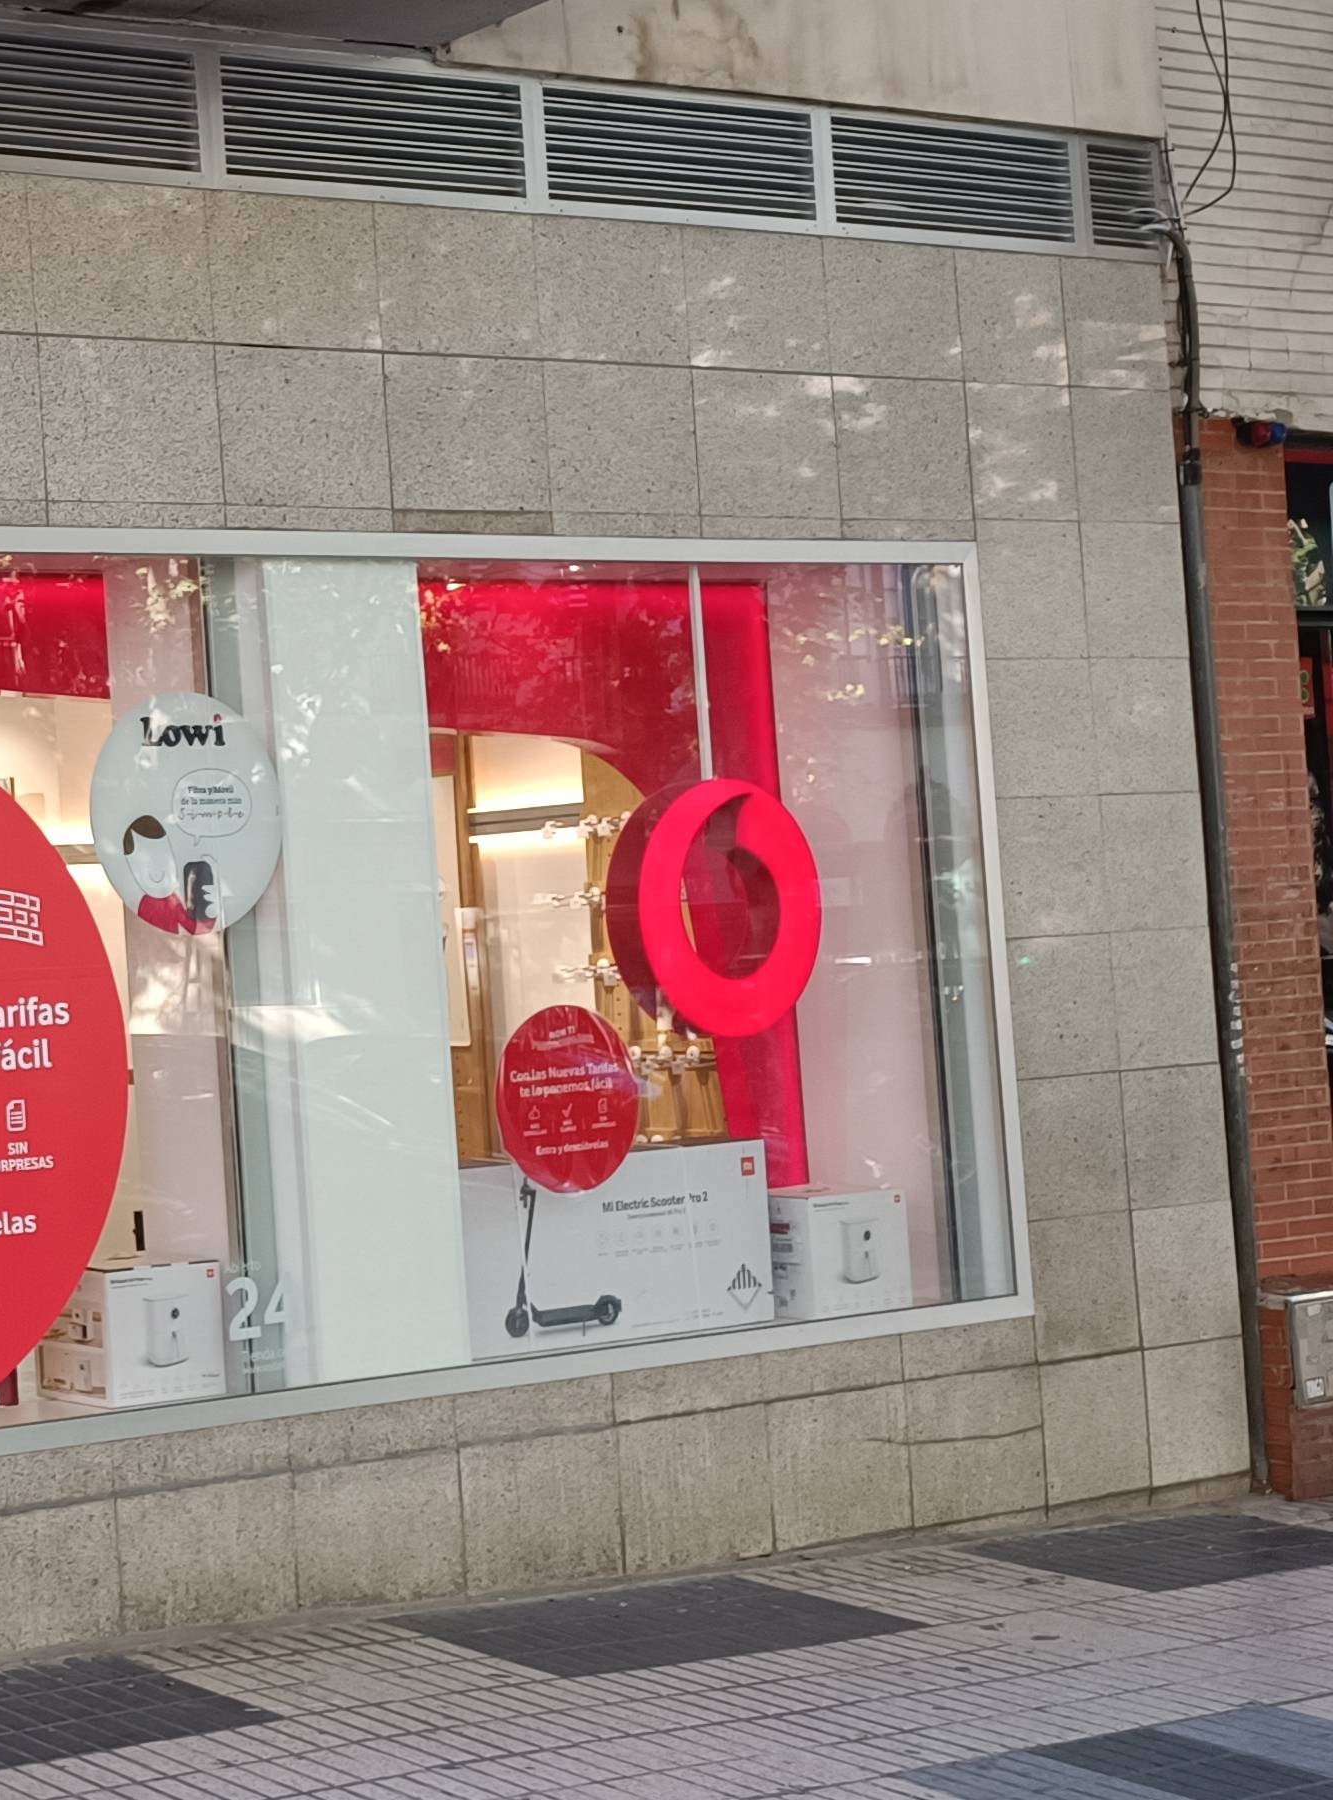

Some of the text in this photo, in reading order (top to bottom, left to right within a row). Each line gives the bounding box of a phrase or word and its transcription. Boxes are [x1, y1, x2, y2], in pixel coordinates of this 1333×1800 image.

[140, 713, 226, 747] Lowi
[7, 1140, 29, 1155] SIN
[602, 1200, 614, 1213] Mi
[615, 1197, 650, 1212] Electric
[650, 1195, 686, 1208] Scooter
[702, 1190, 709, 1202] 2
